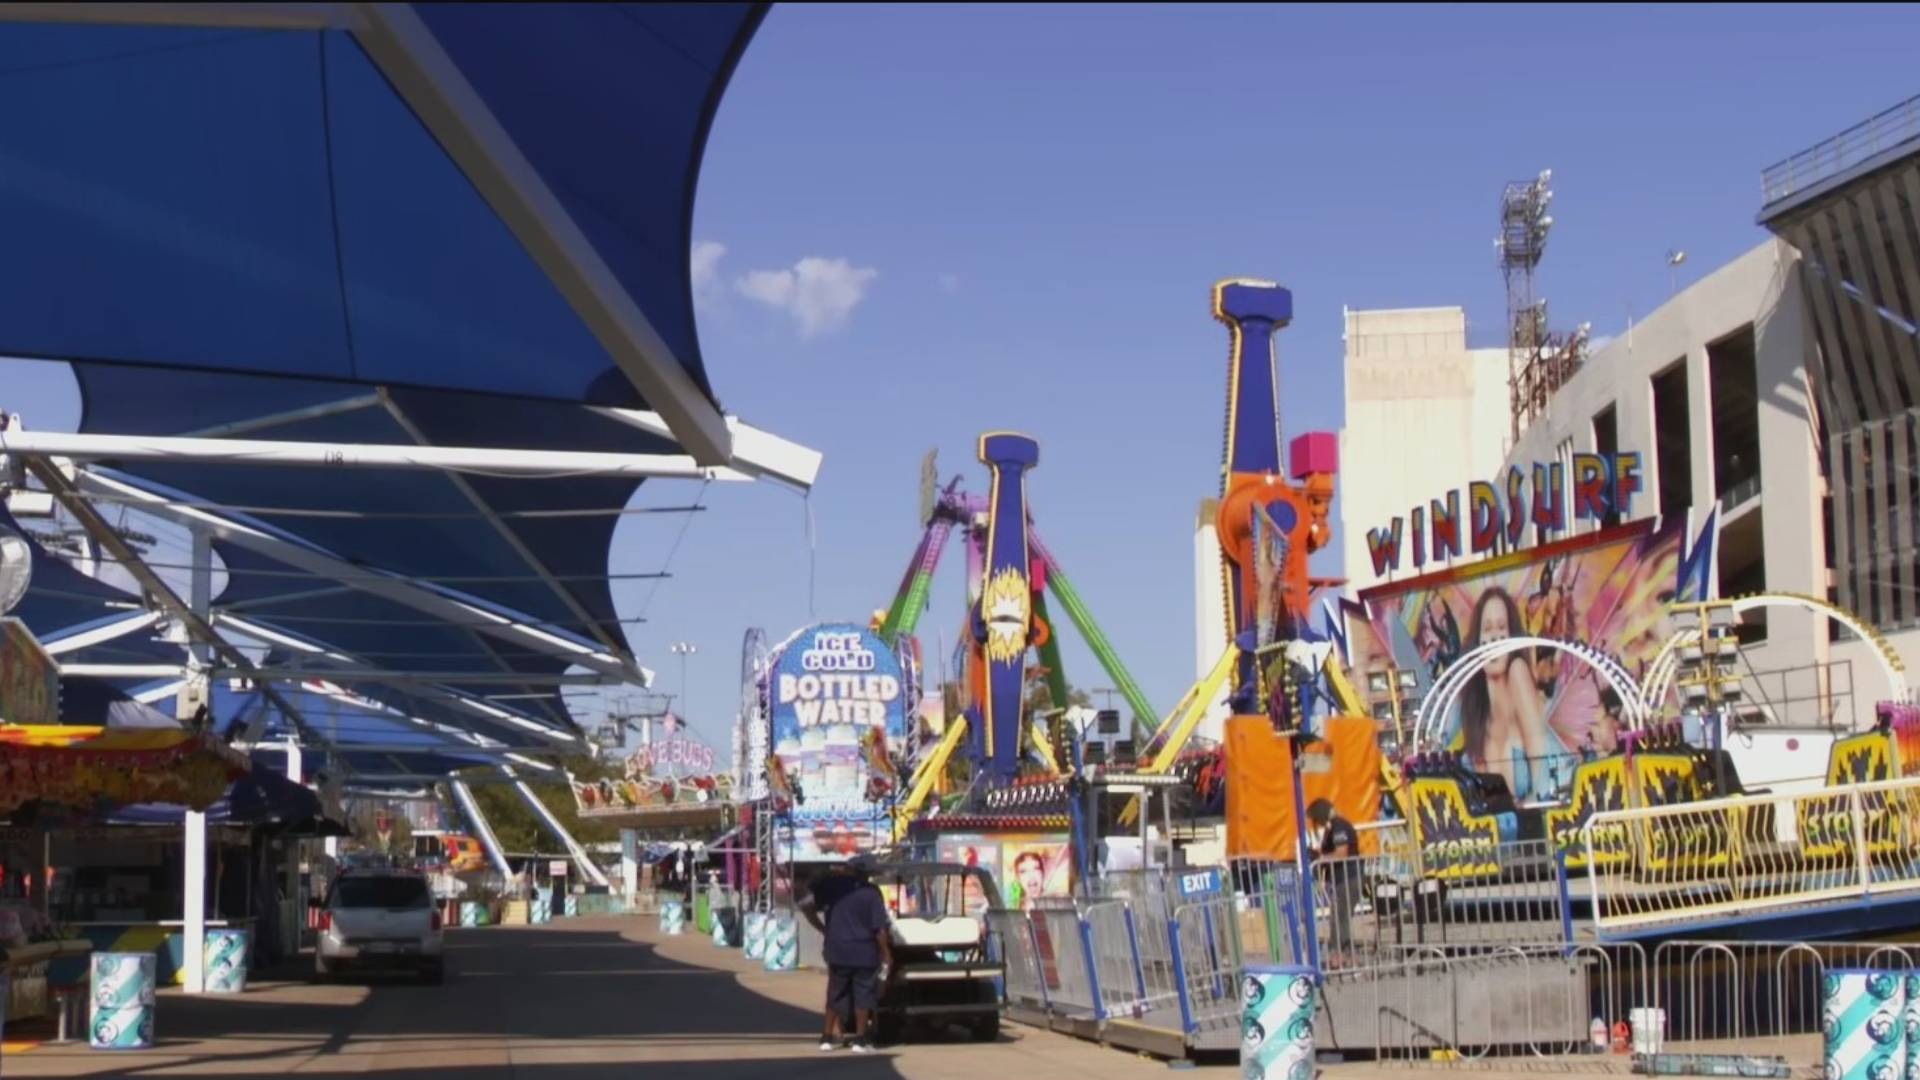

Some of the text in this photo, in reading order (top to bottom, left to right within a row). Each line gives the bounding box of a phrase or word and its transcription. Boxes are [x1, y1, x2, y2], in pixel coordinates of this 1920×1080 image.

[1365, 452, 1643, 577] WINDSURF
[815, 633, 861, 651] ICE
[803, 651, 874, 671] COLD
[779, 674, 899, 703] BOTTLED
[794, 700, 886, 727] WATER
[1556, 823, 1626, 848] STORM
[1425, 836, 1492, 861] STORM
[1183, 871, 1212, 893] EXIT
